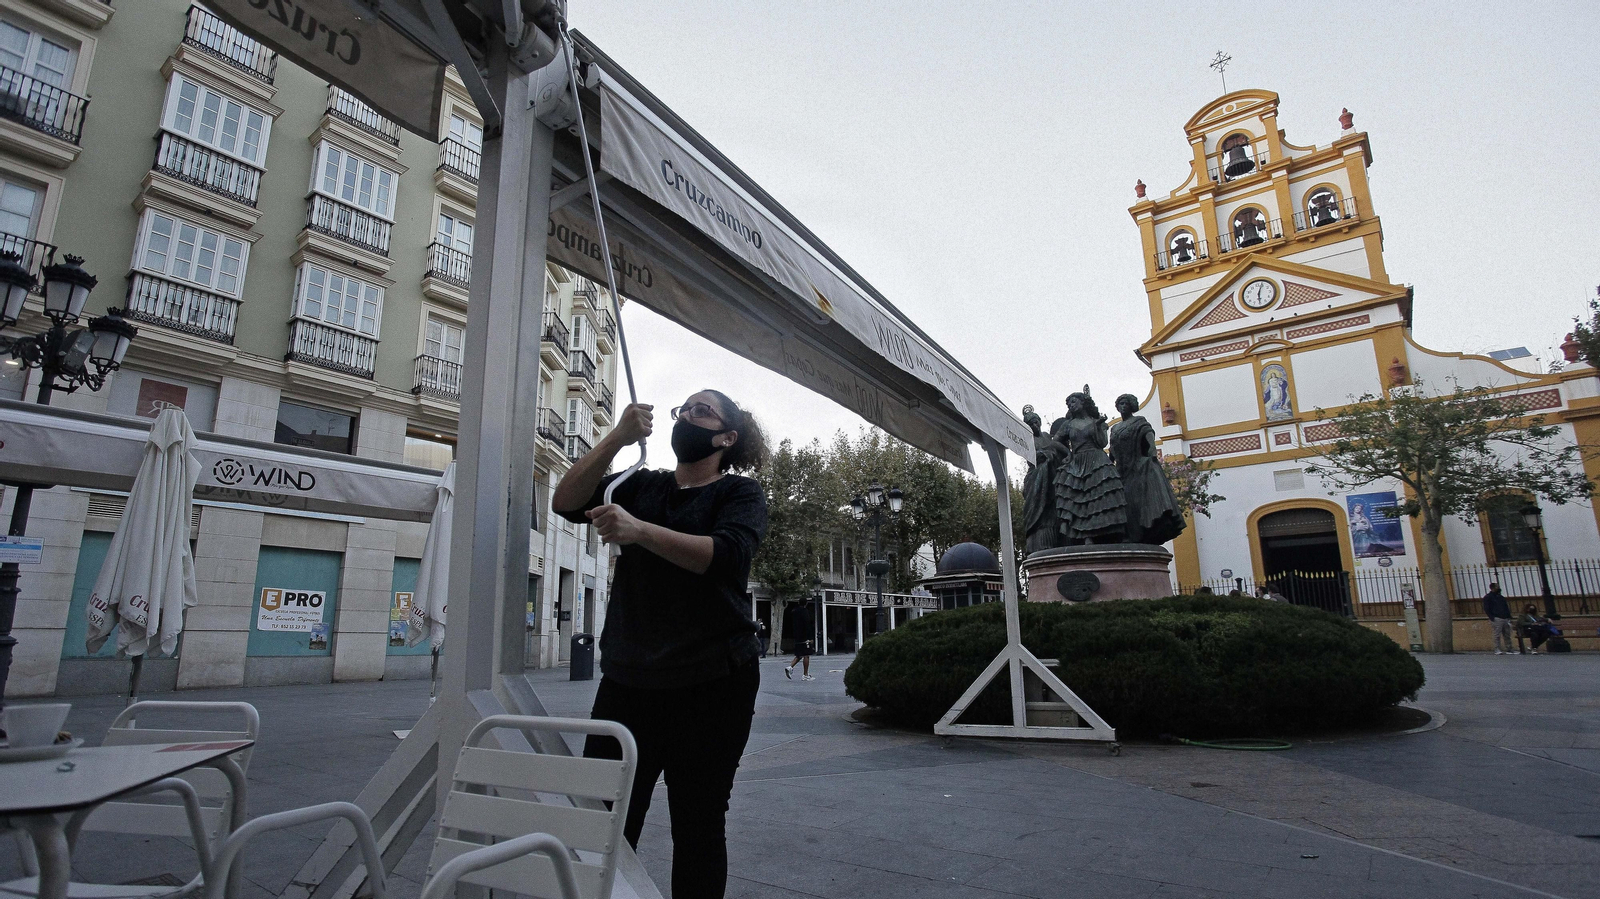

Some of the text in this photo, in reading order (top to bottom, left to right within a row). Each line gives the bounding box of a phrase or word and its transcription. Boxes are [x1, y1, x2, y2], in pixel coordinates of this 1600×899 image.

[660, 159, 763, 250] Cruzcampo
[248, 464, 316, 491] WIND
[284, 592, 323, 608] PRO
[869, 594, 895, 607] TAAS
